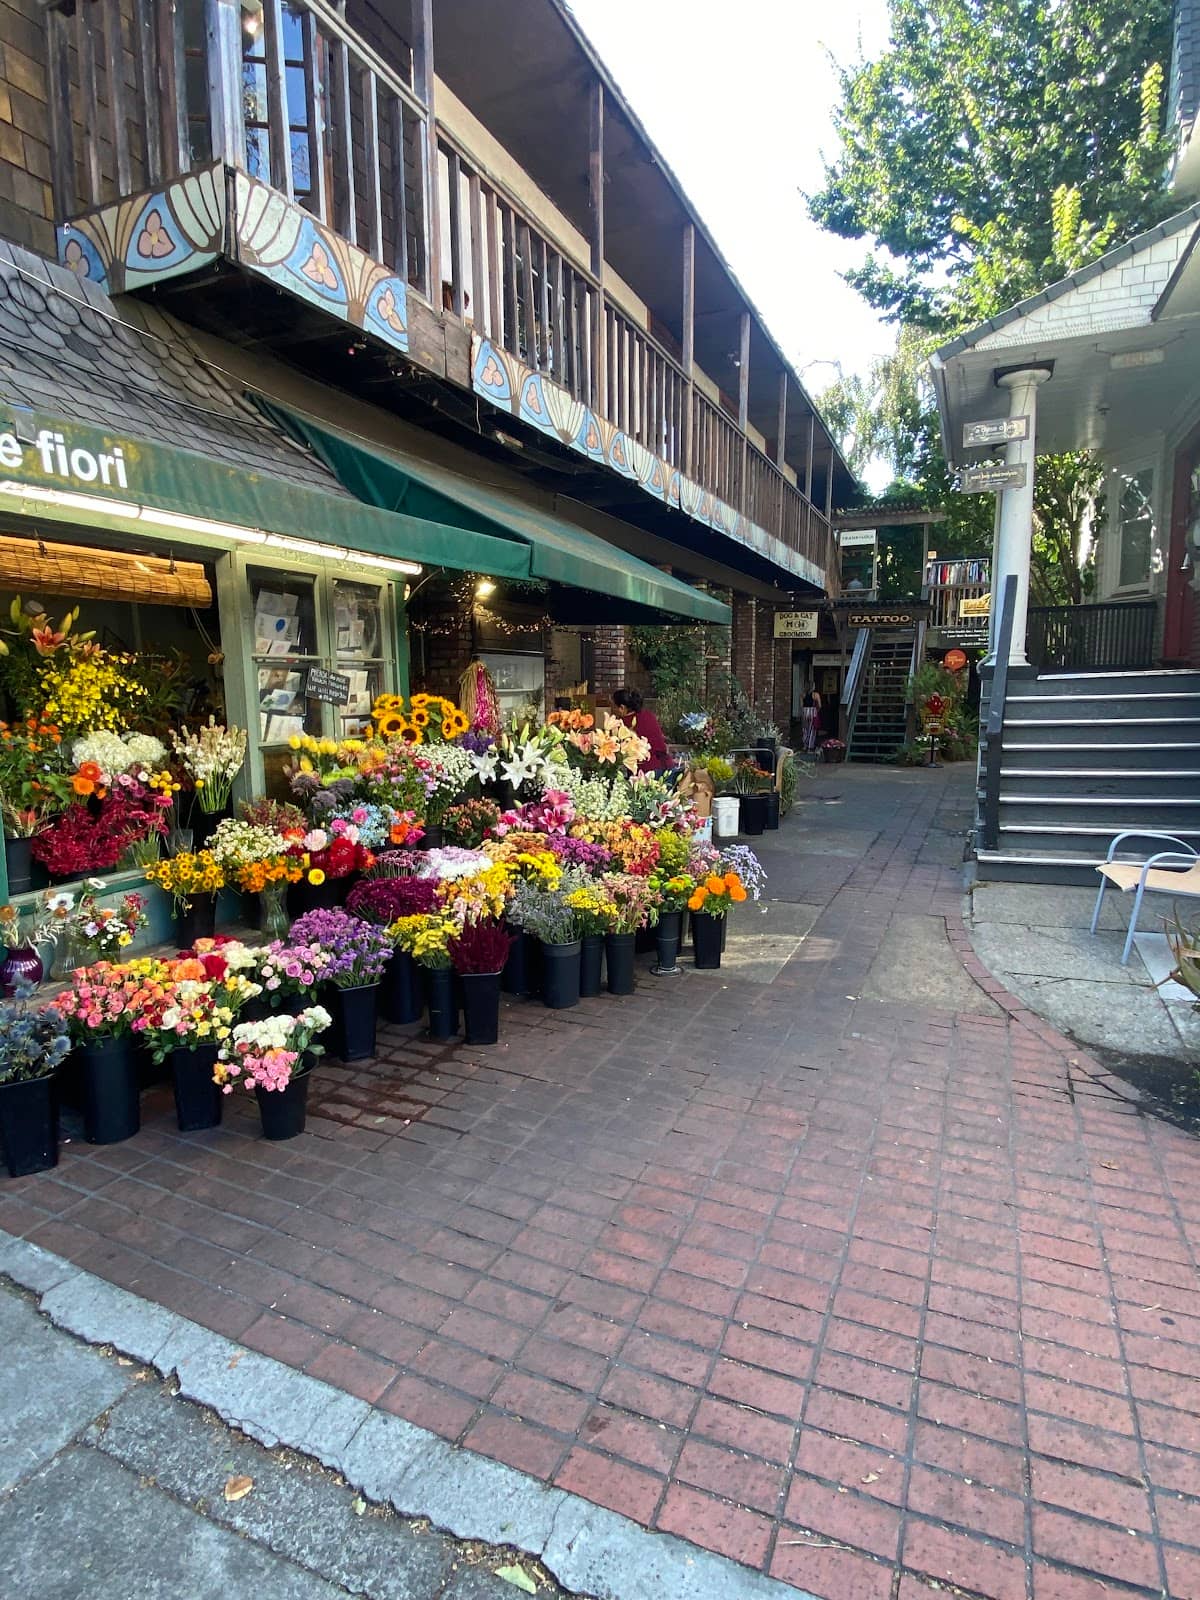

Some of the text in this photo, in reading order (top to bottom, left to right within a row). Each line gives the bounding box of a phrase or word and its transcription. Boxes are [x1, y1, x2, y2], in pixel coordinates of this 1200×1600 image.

[36, 430, 128, 489] fiori
[779, 612, 793, 620] DOG
[801, 611, 814, 619] CAT
[851, 614, 910, 624] TATTOO
